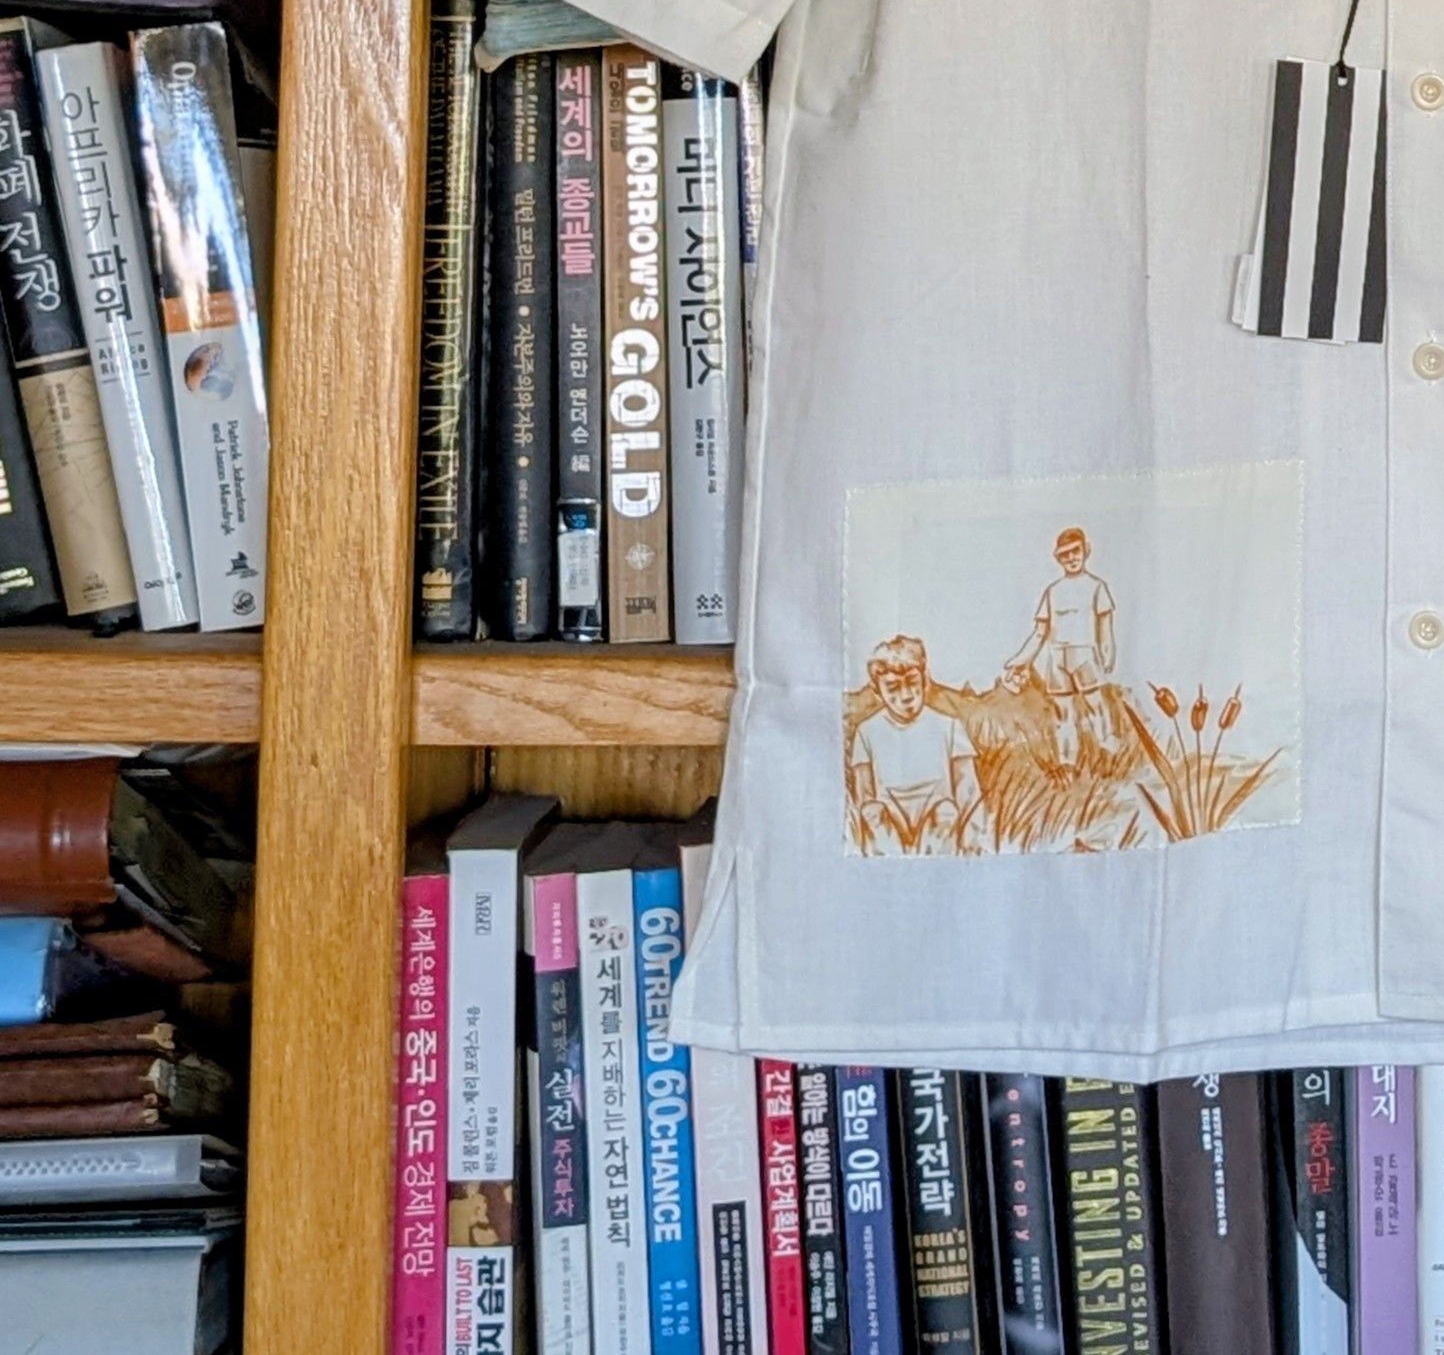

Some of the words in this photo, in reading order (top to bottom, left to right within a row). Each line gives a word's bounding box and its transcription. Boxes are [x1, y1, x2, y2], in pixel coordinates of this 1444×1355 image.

[561, 65, 595, 162] 세계의
[625, 61, 660, 322] TOMORROW'S
[677, 137, 716, 214] 머니
[560, 176, 595, 275] 종교들
[678, 226, 726, 391] 사이언스
[226, 419, 242, 460] Patrick
[610, 328, 663, 519] GOLD
[405, 905, 437, 1021] 세계은행의
[640, 907, 681, 1062] 60TREND
[596, 958, 622, 1035] 세계를
[546, 1069, 575, 1133] 실전
[600, 1041, 626, 1132] 지배하는
[802, 1073, 828, 1124] 일하는
[843, 1085, 877, 1143] 힘의
[1303, 1070, 1330, 1105] 의
[1371, 1065, 1398, 1124] 대지
[647, 1072, 687, 1244] 60CHANCE
[804, 1127, 831, 1181] 방식이
[912, 1067, 953, 1217] 국가전략
[1067, 1109, 1117, 1153] IN
[1305, 1122, 1335, 1195] 종말
[404, 1166, 436, 1224] 경제
[604, 1138, 630, 1192] 자연
[847, 1148, 883, 1213] 이동
[1008, 1088, 1030, 1242] entropy
[605, 1196, 632, 1249] 법칙
[807, 1184, 834, 1234] 다르다
[404, 1230, 437, 1277] 전망
[456, 1257, 474, 1287] LAST
[456, 1289, 474, 1306] TO
[456, 1307, 474, 1342] BUILT
